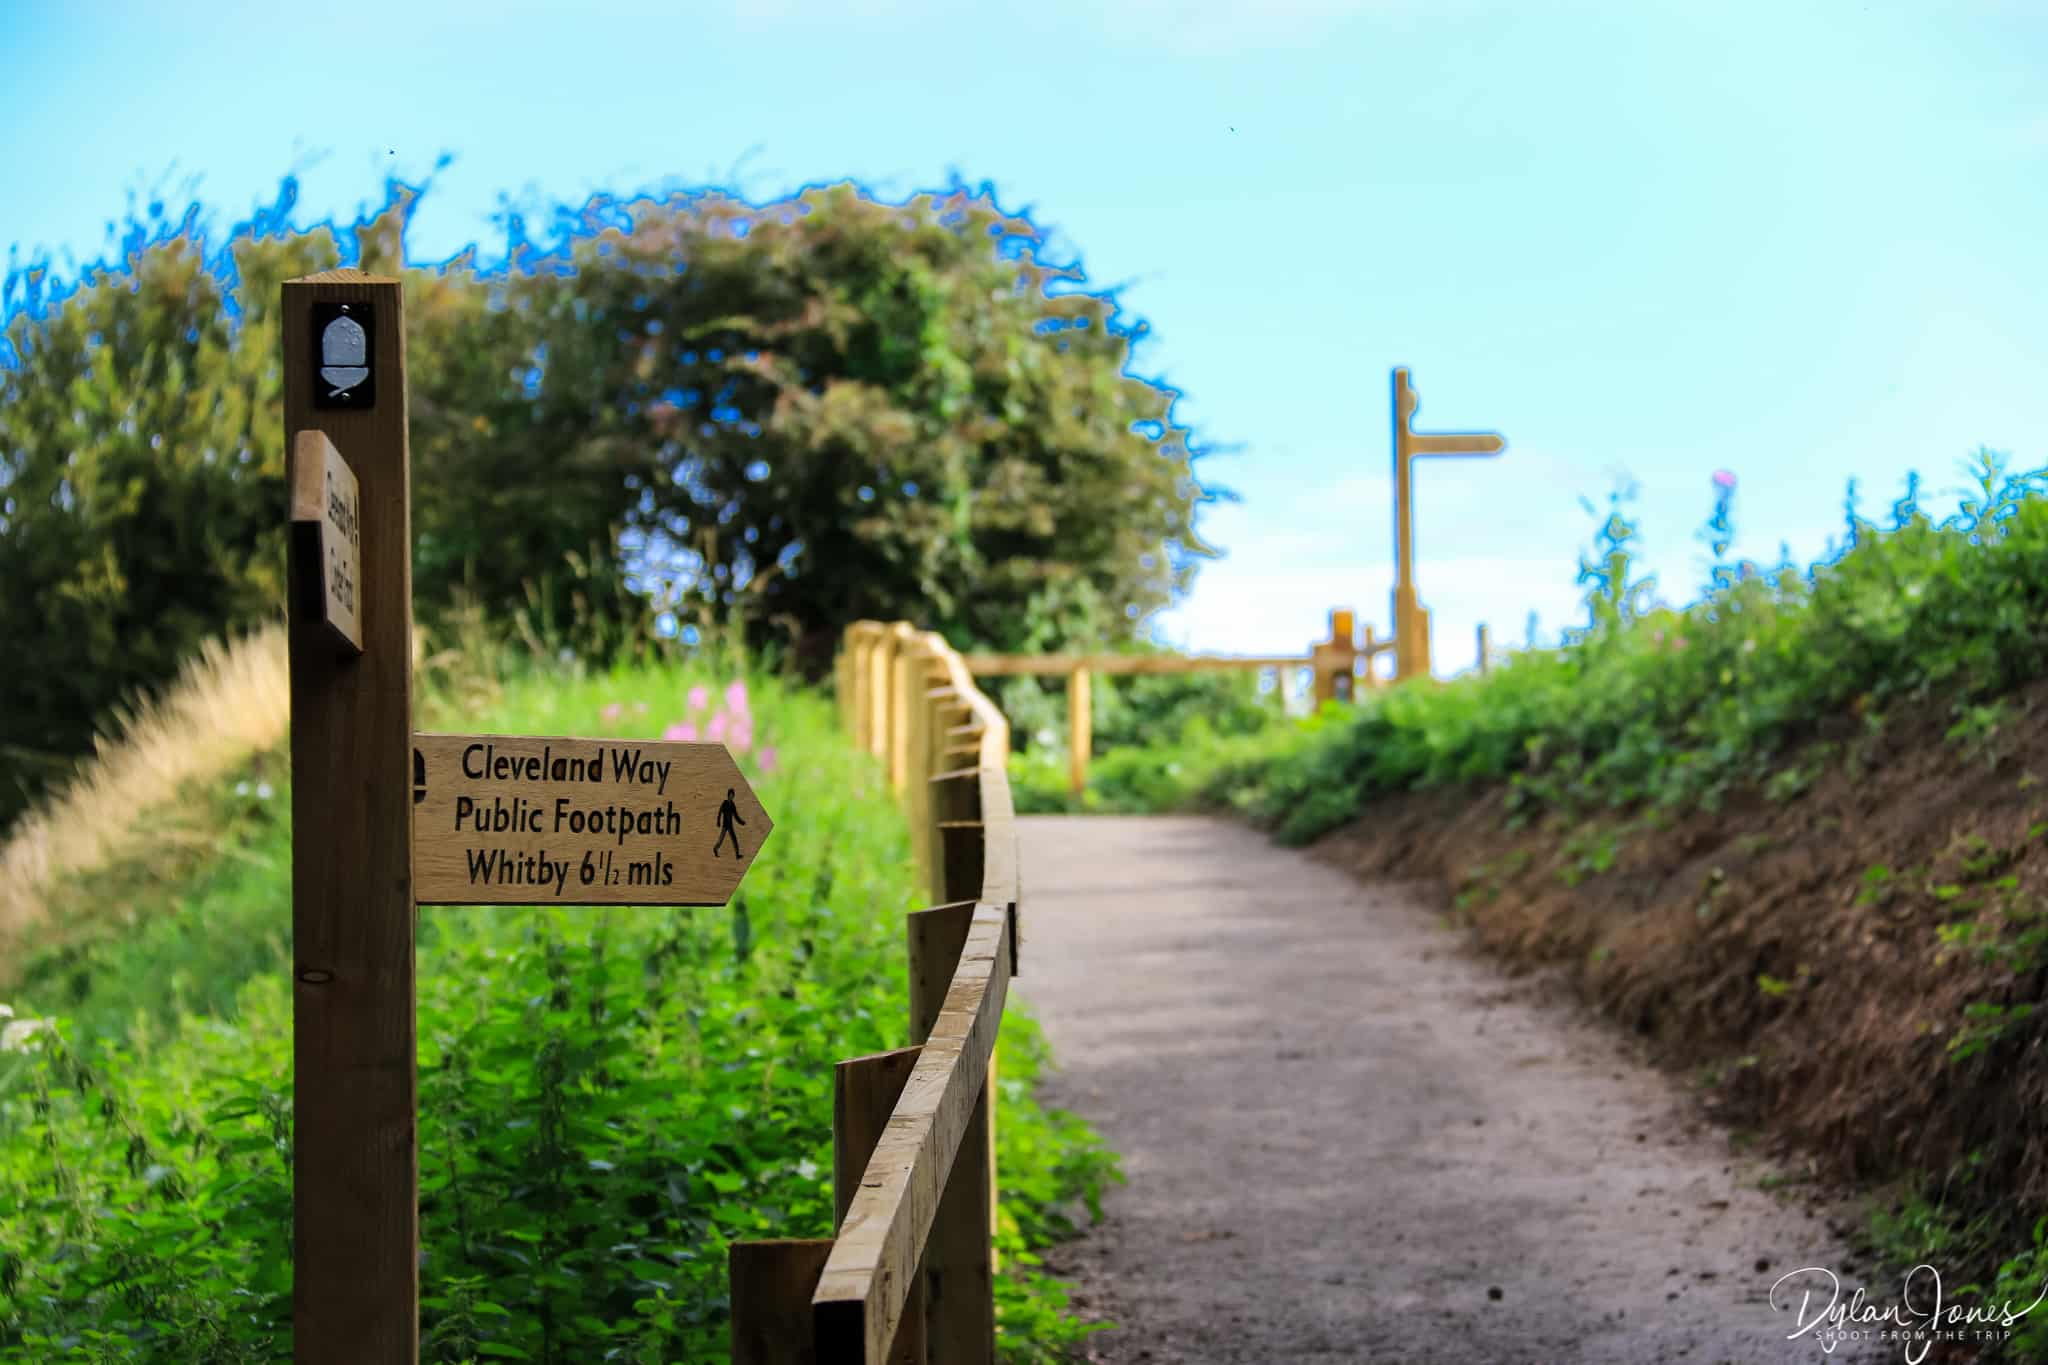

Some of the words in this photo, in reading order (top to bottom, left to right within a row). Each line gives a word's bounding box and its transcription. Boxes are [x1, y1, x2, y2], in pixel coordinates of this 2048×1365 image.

[462, 744, 603, 783] Cleveland
[612, 748, 671, 795] Way
[455, 796, 543, 833] Public
[554, 798, 681, 846] Footpath
[466, 849, 569, 896] Whitby
[627, 851, 673, 886] mls
